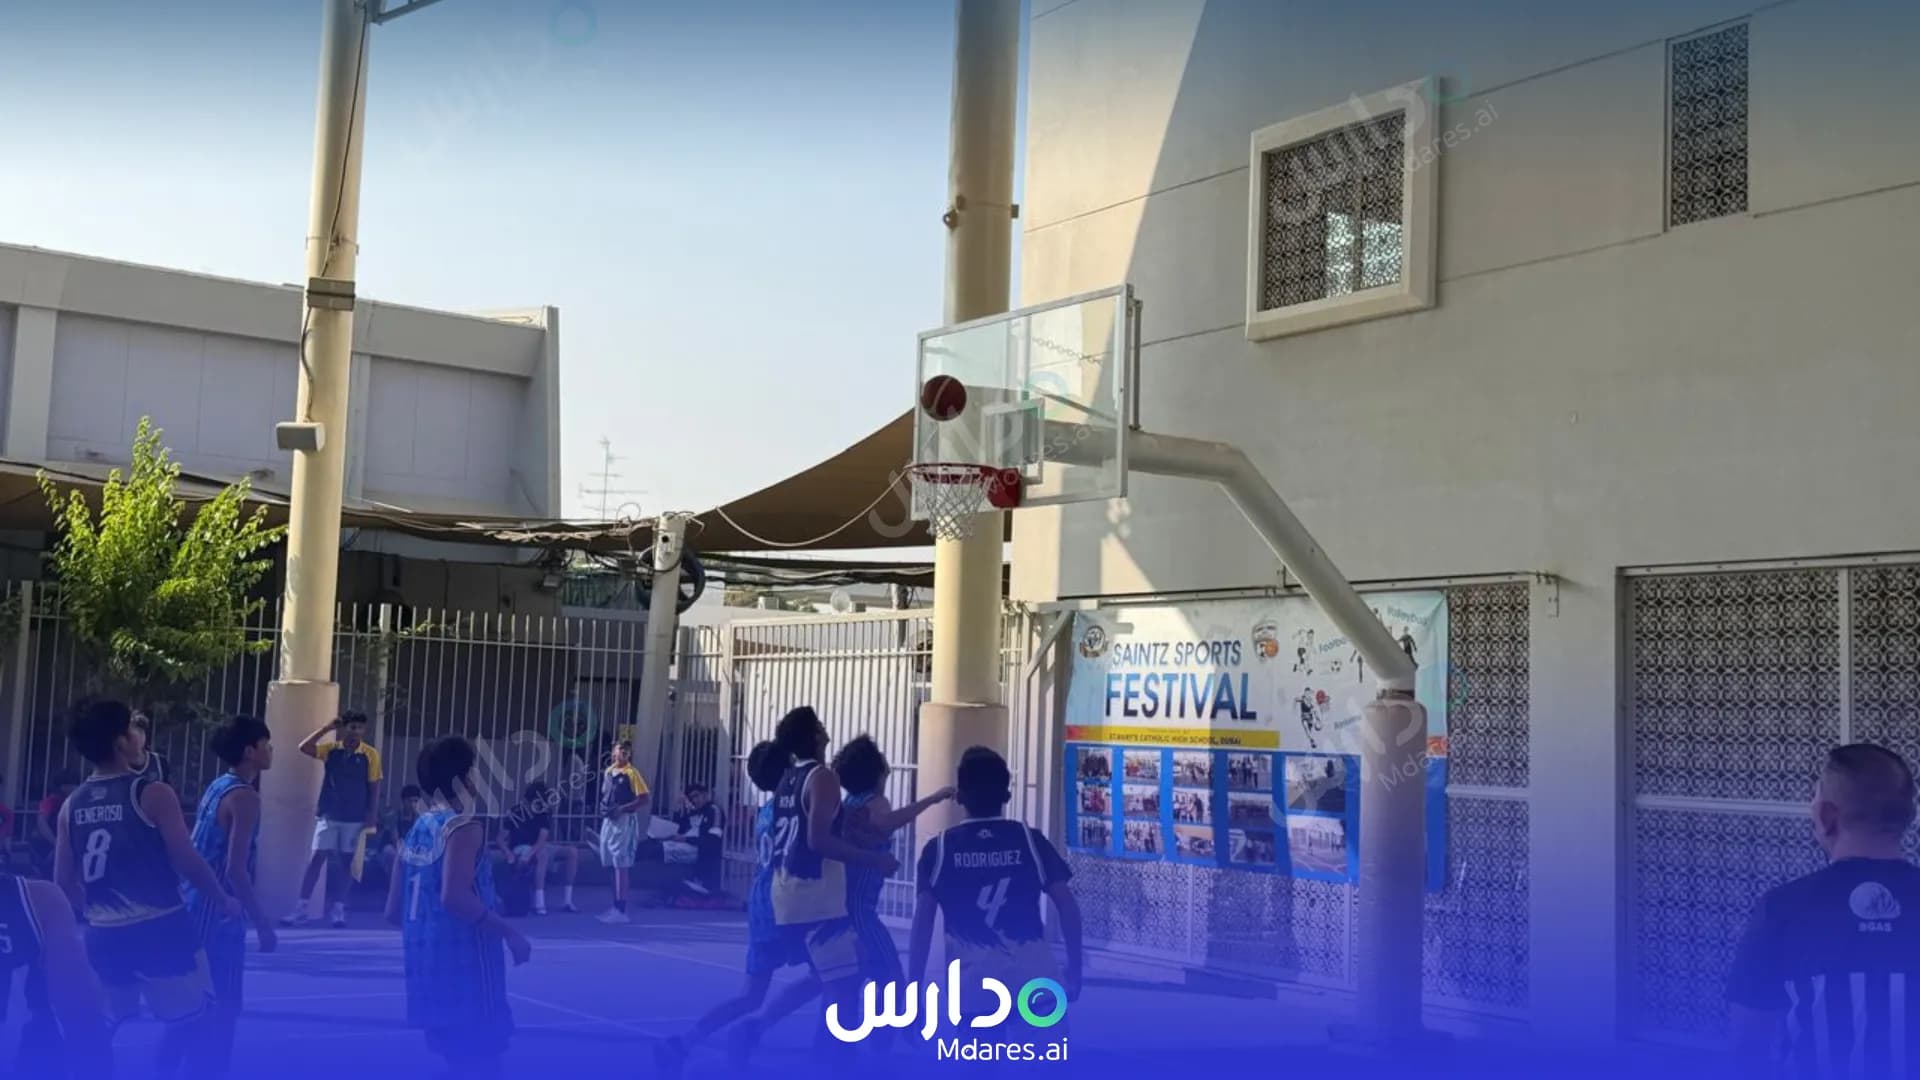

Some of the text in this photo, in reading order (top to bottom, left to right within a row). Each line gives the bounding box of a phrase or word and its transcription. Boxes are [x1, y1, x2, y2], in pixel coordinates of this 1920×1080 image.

[1113, 640, 1241, 666] SAINTZ SPORTS
[1105, 672, 1257, 720] FESTIVAL
[83, 828, 112, 883] 8
[953, 848, 1023, 868] RODRIGUEZ
[976, 876, 1011, 928] 4
